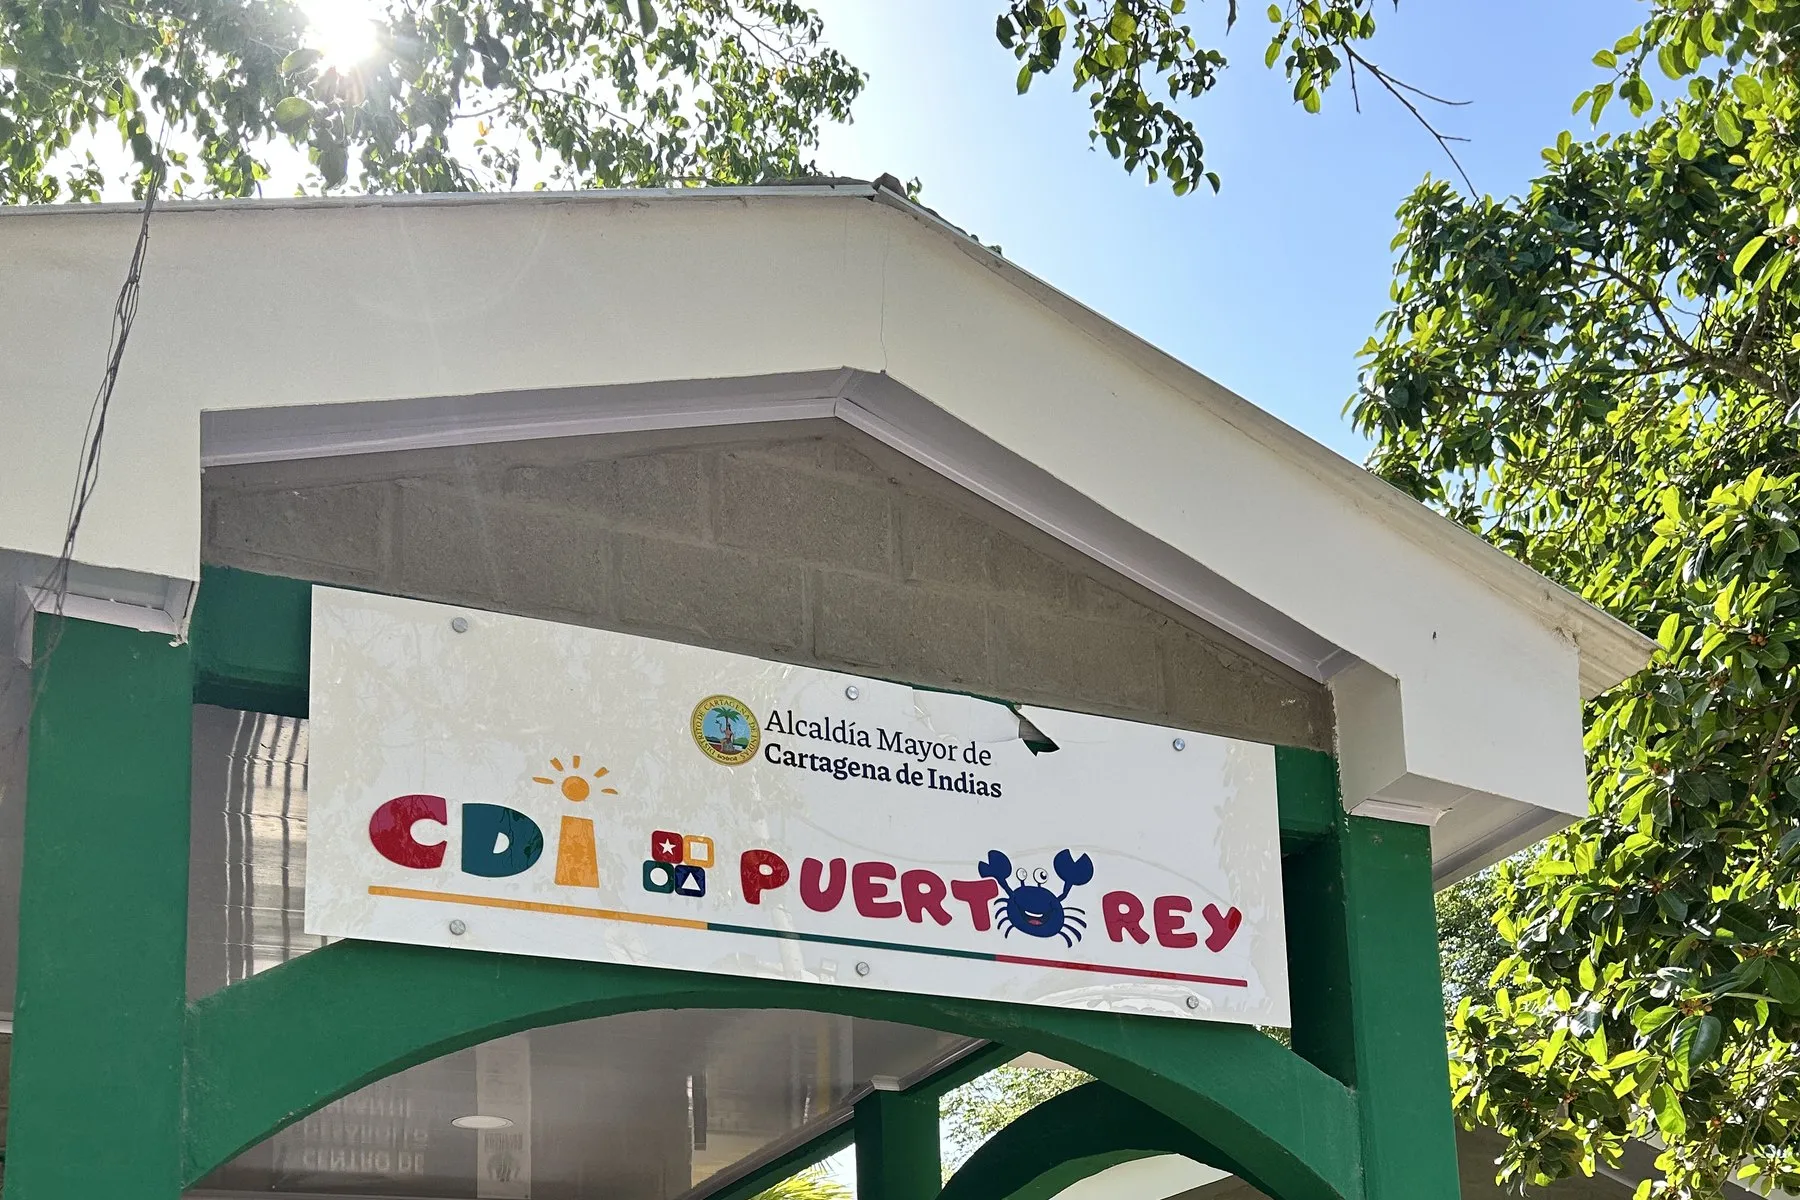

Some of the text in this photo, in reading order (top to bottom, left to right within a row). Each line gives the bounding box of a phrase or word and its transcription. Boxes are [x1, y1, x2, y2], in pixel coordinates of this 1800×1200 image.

[764, 710, 992, 767] Alcaldía Mayor de
[764, 742, 1003, 798] Cartagena de Indias
[1101, 890, 1243, 953] REY
